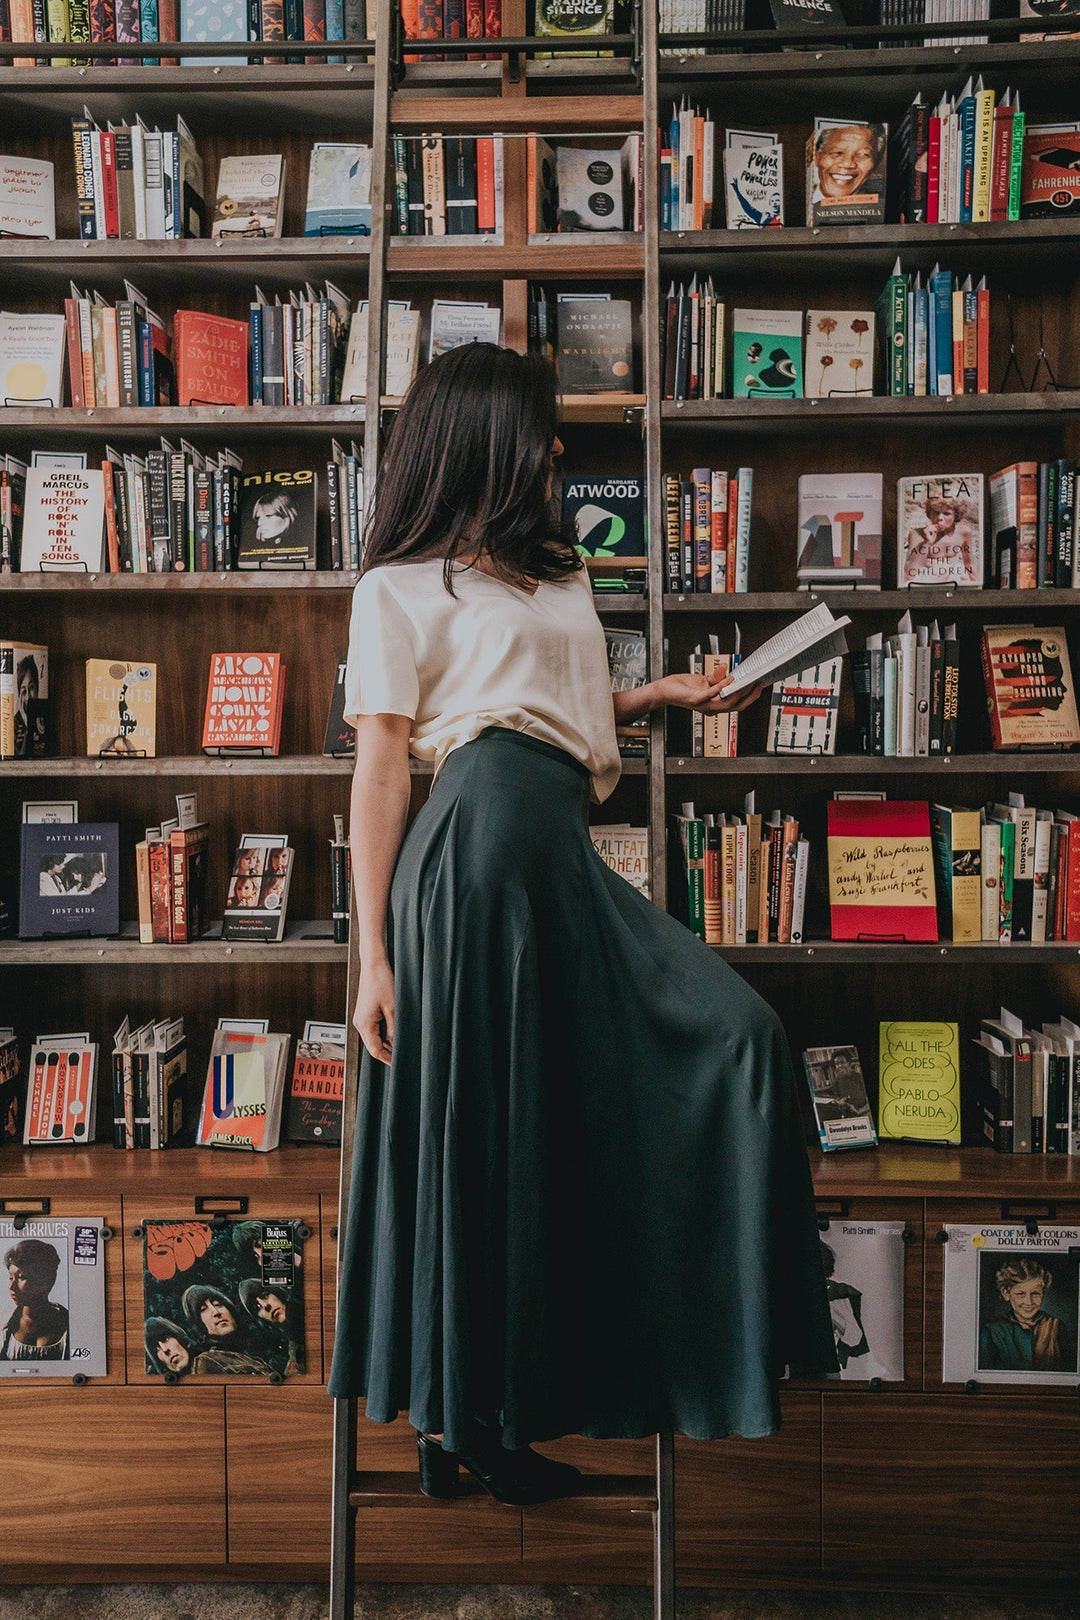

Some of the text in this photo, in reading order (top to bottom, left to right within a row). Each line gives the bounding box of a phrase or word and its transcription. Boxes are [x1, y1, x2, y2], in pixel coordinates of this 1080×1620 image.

[546, 5, 603, 15] SILENCE
[782, 0, 833, 12] SILENCE
[73, 131, 81, 142] ON
[964, 105, 975, 166] ELLA BAKER
[979, 95, 991, 186] THIS IS AN UPRISING
[1011, 115, 1024, 164] DIRECT ACTION
[75, 142, 83, 172] LEONARD
[82, 131, 94, 199] LEONARD COHEN
[1032, 175, 1080, 189] FAHRENHE
[1054, 192, 1069, 204] 451
[816, 207, 882, 218] NELSON MANDELA
[570, 313, 619, 321] MICHAEL
[566, 323, 623, 331] ONDAATJE
[121, 329, 131, 348] KATE
[190, 331, 241, 353] ZADIE
[186, 346, 241, 369] SMITH
[122, 350, 133, 389] ATKINSON
[202, 364, 228, 381] ON
[187, 377, 242, 399] BEAUTY
[42, 481, 89, 489] MARCUS
[50, 473, 82, 481] GREIL
[171, 454, 186, 502] CHUCK BERRY
[243, 470, 313, 487] nico
[54, 490, 76, 498] THE
[328, 464, 337, 523] LOW DOWN
[566, 484, 640, 498] ATWOOD
[666, 476, 680, 503] JEFF
[911, 480, 971, 500] FLEA
[1060, 475, 1068, 504] COATES
[1066, 471, 1074, 507] TA-NEHISI
[40, 497, 89, 505] HISTORY
[199, 489, 208, 510] Dino
[48, 513, 79, 521] ROCK
[56, 505, 70, 513] OF
[48, 529, 76, 537] ROLL
[667, 506, 680, 549] TWEEDY
[910, 545, 971, 555] ACID FOR
[1064, 526, 1073, 566] THE WATER
[41, 552, 80, 560] SONGS
[930, 557, 952, 565] THE
[907, 566, 973, 577] CHILDREN
[214, 656, 275, 676] BARON
[1001, 652, 1043, 663] STAMPED
[1020, 663, 1045, 675] FROM
[1028, 675, 1047, 686] THE
[94, 685, 152, 704] FLIGHTS
[211, 685, 272, 703] HOME
[781, 695, 832, 706] DEAD SOULS
[943, 665, 953, 721] RESURRECTION
[950, 667, 959, 719] LEO TOLSTOY
[1013, 686, 1063, 698] BEGINNING
[109, 708, 136, 723] OLGA
[91, 723, 152, 738] TOKARCZUK
[46, 834, 103, 842] PATTI SMITH
[593, 839, 647, 856] SALT FAT
[737, 831, 746, 872] Repertoire
[842, 846, 867, 863] Wild
[873, 842, 930, 861] Raspberries
[1018, 820, 1031, 875] Six Seasons
[601, 856, 649, 873] ID HEAT
[725, 834, 734, 885] HIPPIE FOOD
[749, 848, 760, 885] Season
[865, 859, 876, 873] by
[865, 867, 898, 884] Warhol
[907, 862, 927, 876] and
[173, 853, 185, 925] When We Were Good
[784, 863, 795, 903] Edna Lewis
[51, 906, 96, 915] JUST KIDS
[895, 1040, 944, 1053] ALL THE
[298, 1062, 345, 1079] RAYMON
[902, 1056, 936, 1069] ODES
[32, 1067, 43, 1118] MICHAEL
[54, 1063, 67, 1122] MOONGLOW
[213, 1053, 267, 1120] ULYSSES
[293, 1078, 344, 1097] CHANDLE
[898, 1089, 940, 1101] PABLO
[40, 1092, 52, 1137] CHABON
[301, 1112, 337, 1126] Goodbye
[894, 1105, 947, 1118] NERUDA
[209, 1131, 253, 1145] JAMES JOYCE
[828, 1125, 852, 1134] Gwendolyn
[0, 1222, 69, 1238] THA ARRIVES
[266, 1227, 288, 1238] BEATLES
[842, 1226, 857, 1235] Patti
[857, 1226, 876, 1235] Smith
[980, 1228, 1079, 1240] COAT OF MAY COLORS
[997, 1237, 1060, 1247] DOLLY PARTON
